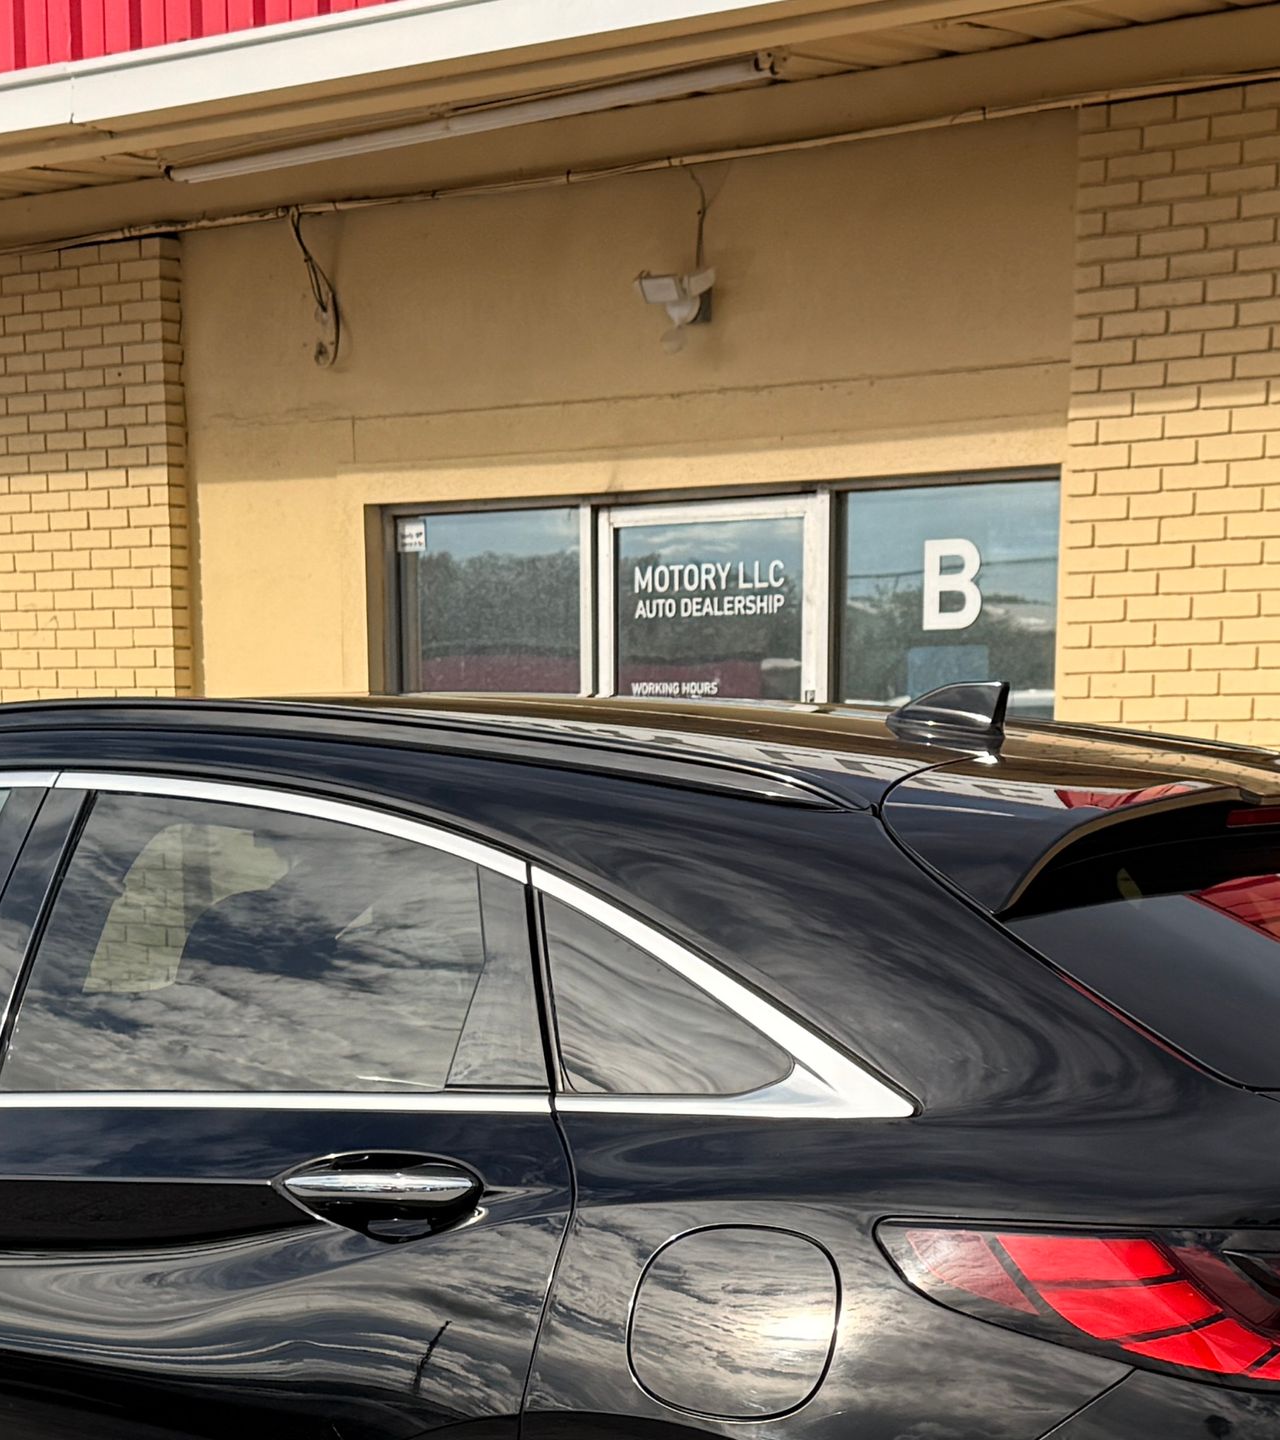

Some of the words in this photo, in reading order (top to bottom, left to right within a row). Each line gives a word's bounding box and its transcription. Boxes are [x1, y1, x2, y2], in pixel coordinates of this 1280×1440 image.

[634, 561, 731, 594] MOTORY
[738, 560, 785, 589] LLC
[923, 538, 982, 631] B
[634, 598, 677, 619] AUTO
[680, 594, 785, 618] DEALERSHIP
[631, 682, 680, 697] WORKING
[681, 682, 718, 695] HOURS
